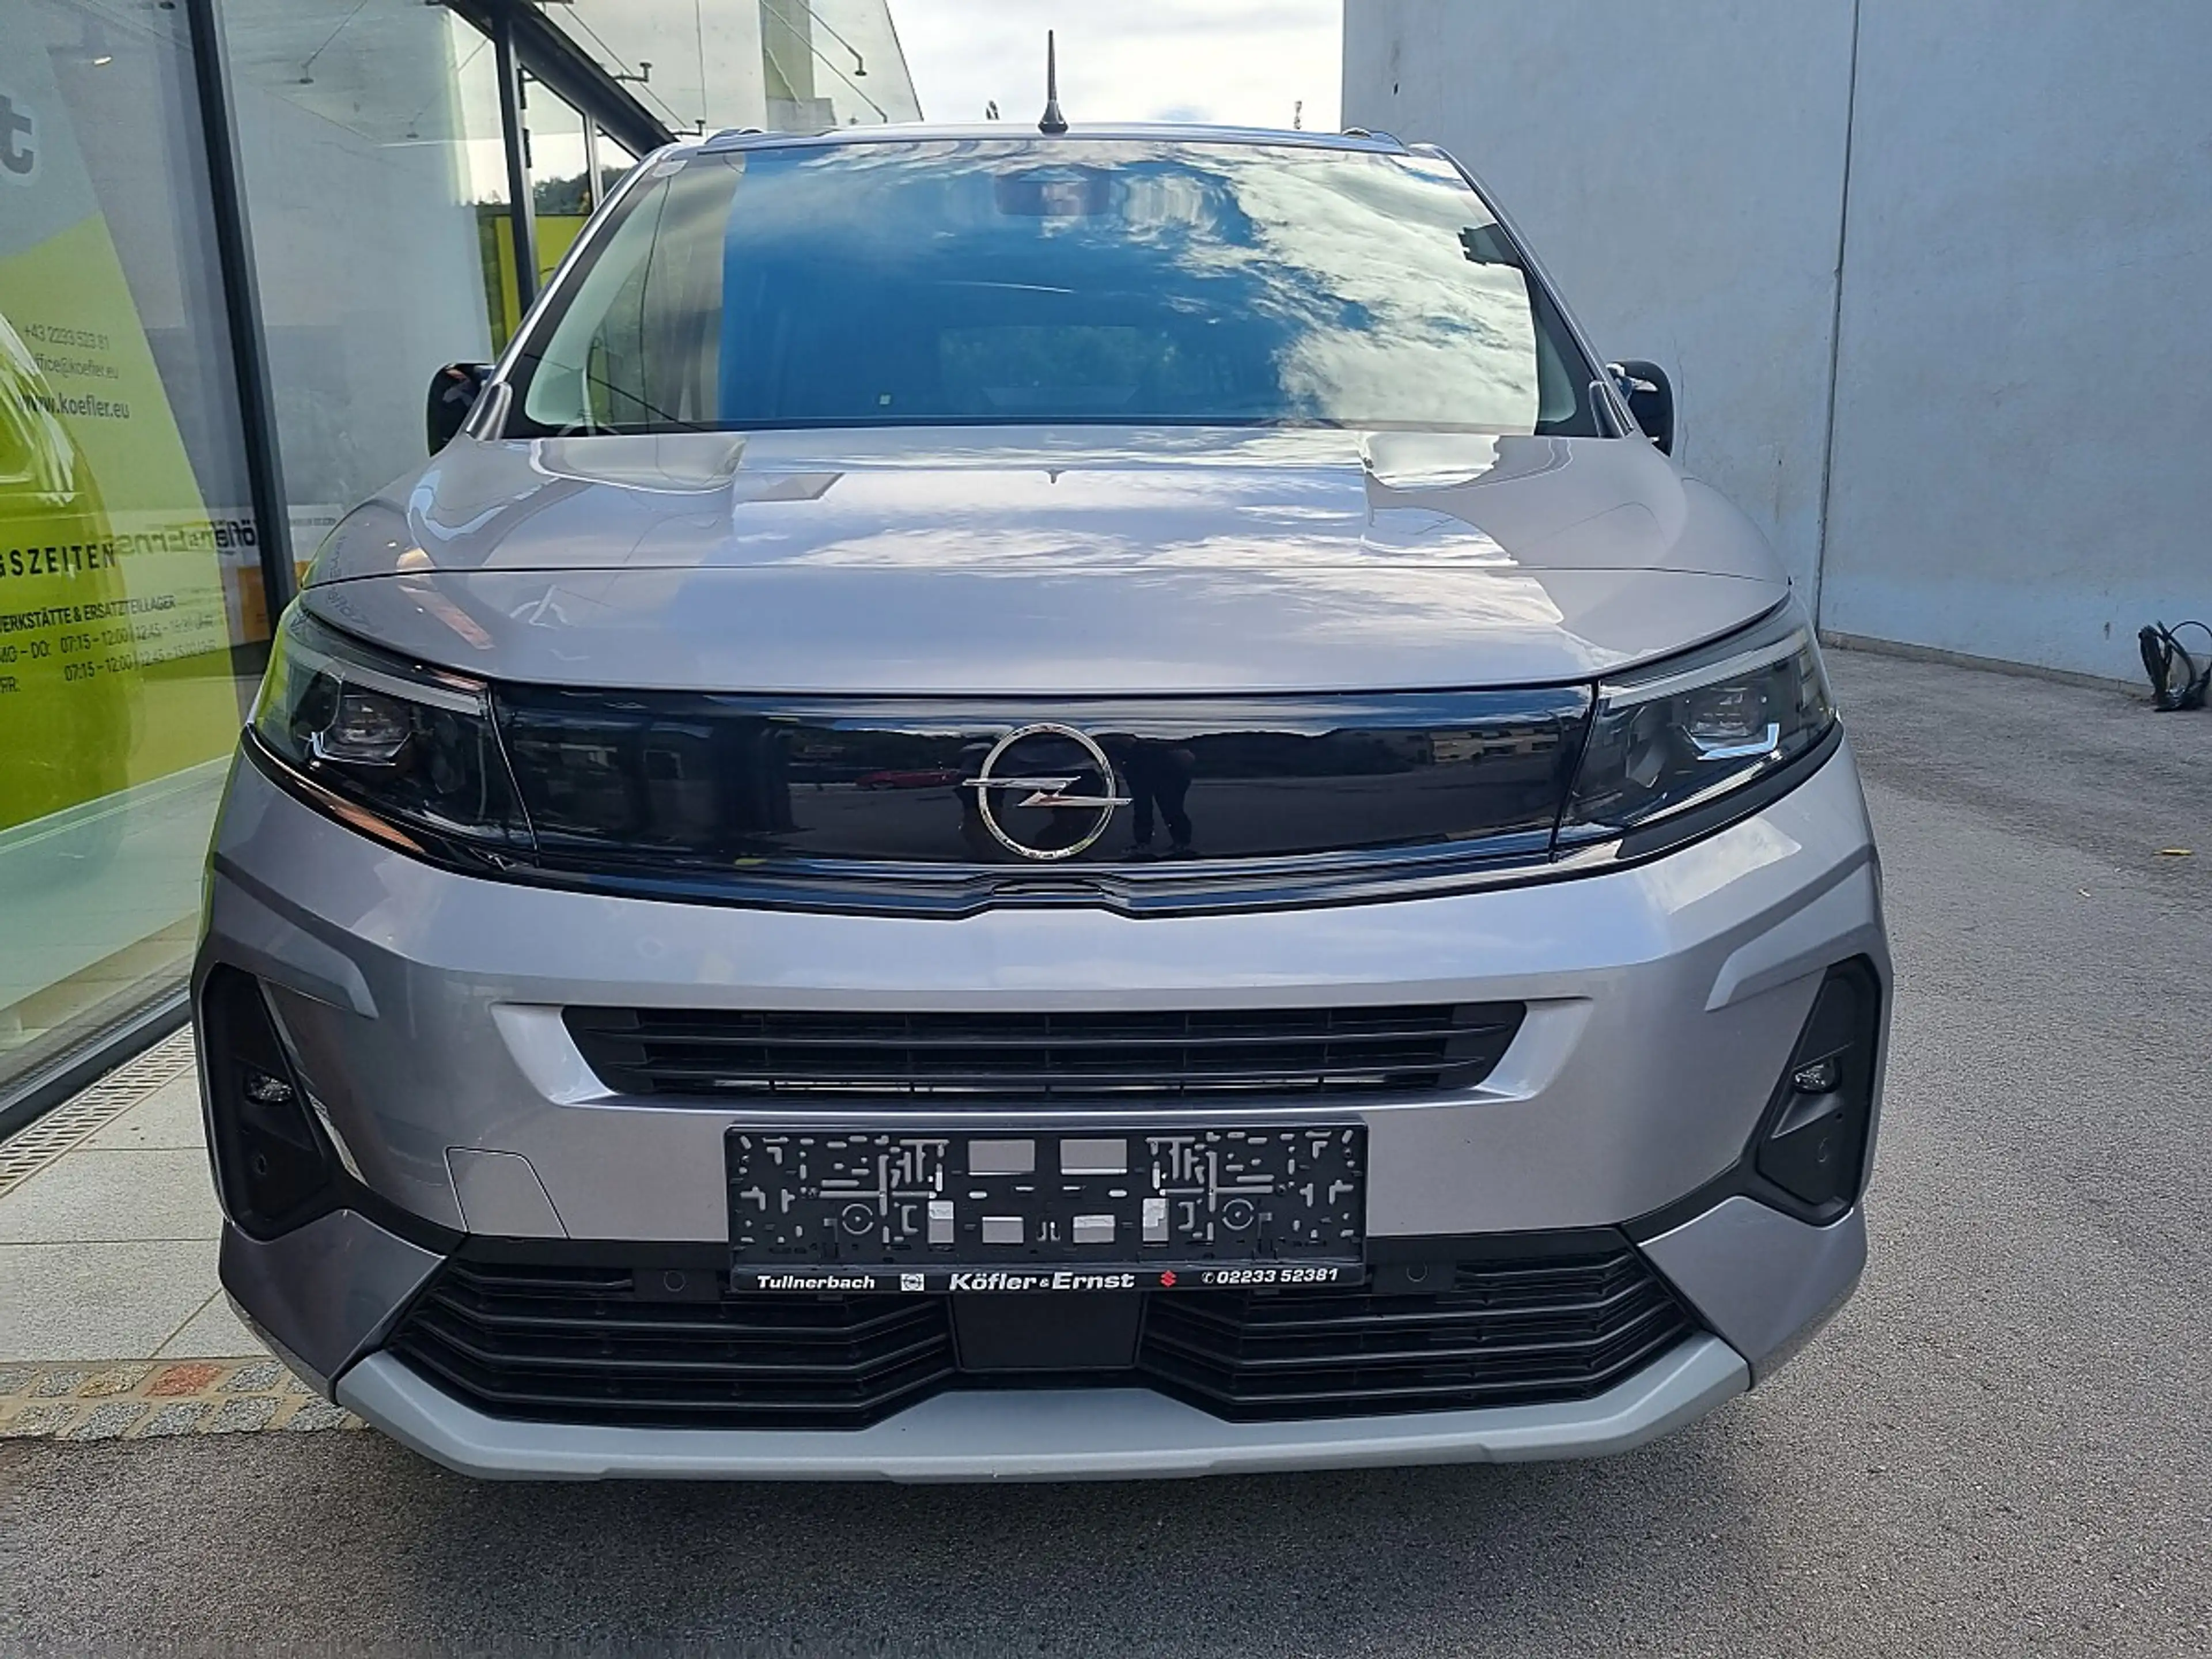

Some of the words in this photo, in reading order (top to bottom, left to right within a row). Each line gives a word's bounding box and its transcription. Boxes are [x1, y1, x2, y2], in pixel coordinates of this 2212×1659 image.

[33, 352, 119, 379] ffice@koefler.eu
[74, 607, 82, 622] &
[84, 595, 175, 620] ERSATZTEILLAGER
[757, 1275, 876, 1290] Tullnerbach
[1217, 1270, 1277, 1284] 02233
[1280, 1267, 1338, 1283] 52381
